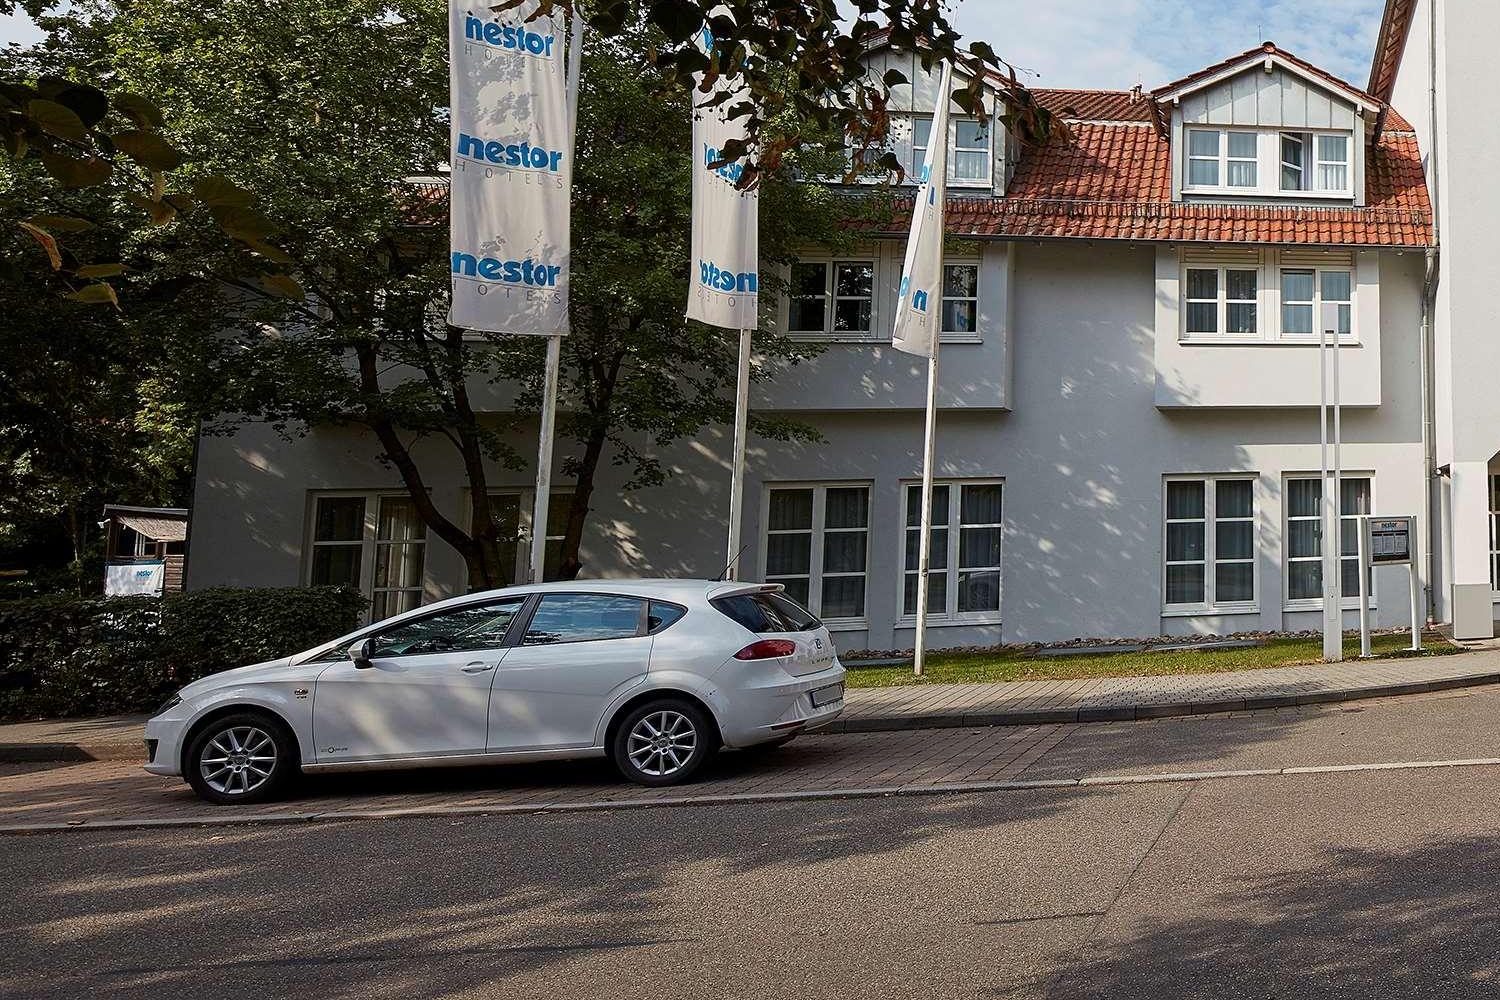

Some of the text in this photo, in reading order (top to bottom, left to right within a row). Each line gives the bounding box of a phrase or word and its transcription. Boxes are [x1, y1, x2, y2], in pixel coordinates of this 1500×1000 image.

[465, 17, 555, 57] nestor
[457, 133, 562, 172] nestor
[455, 159, 563, 189] HOTELS
[452, 252, 561, 287] nestor
